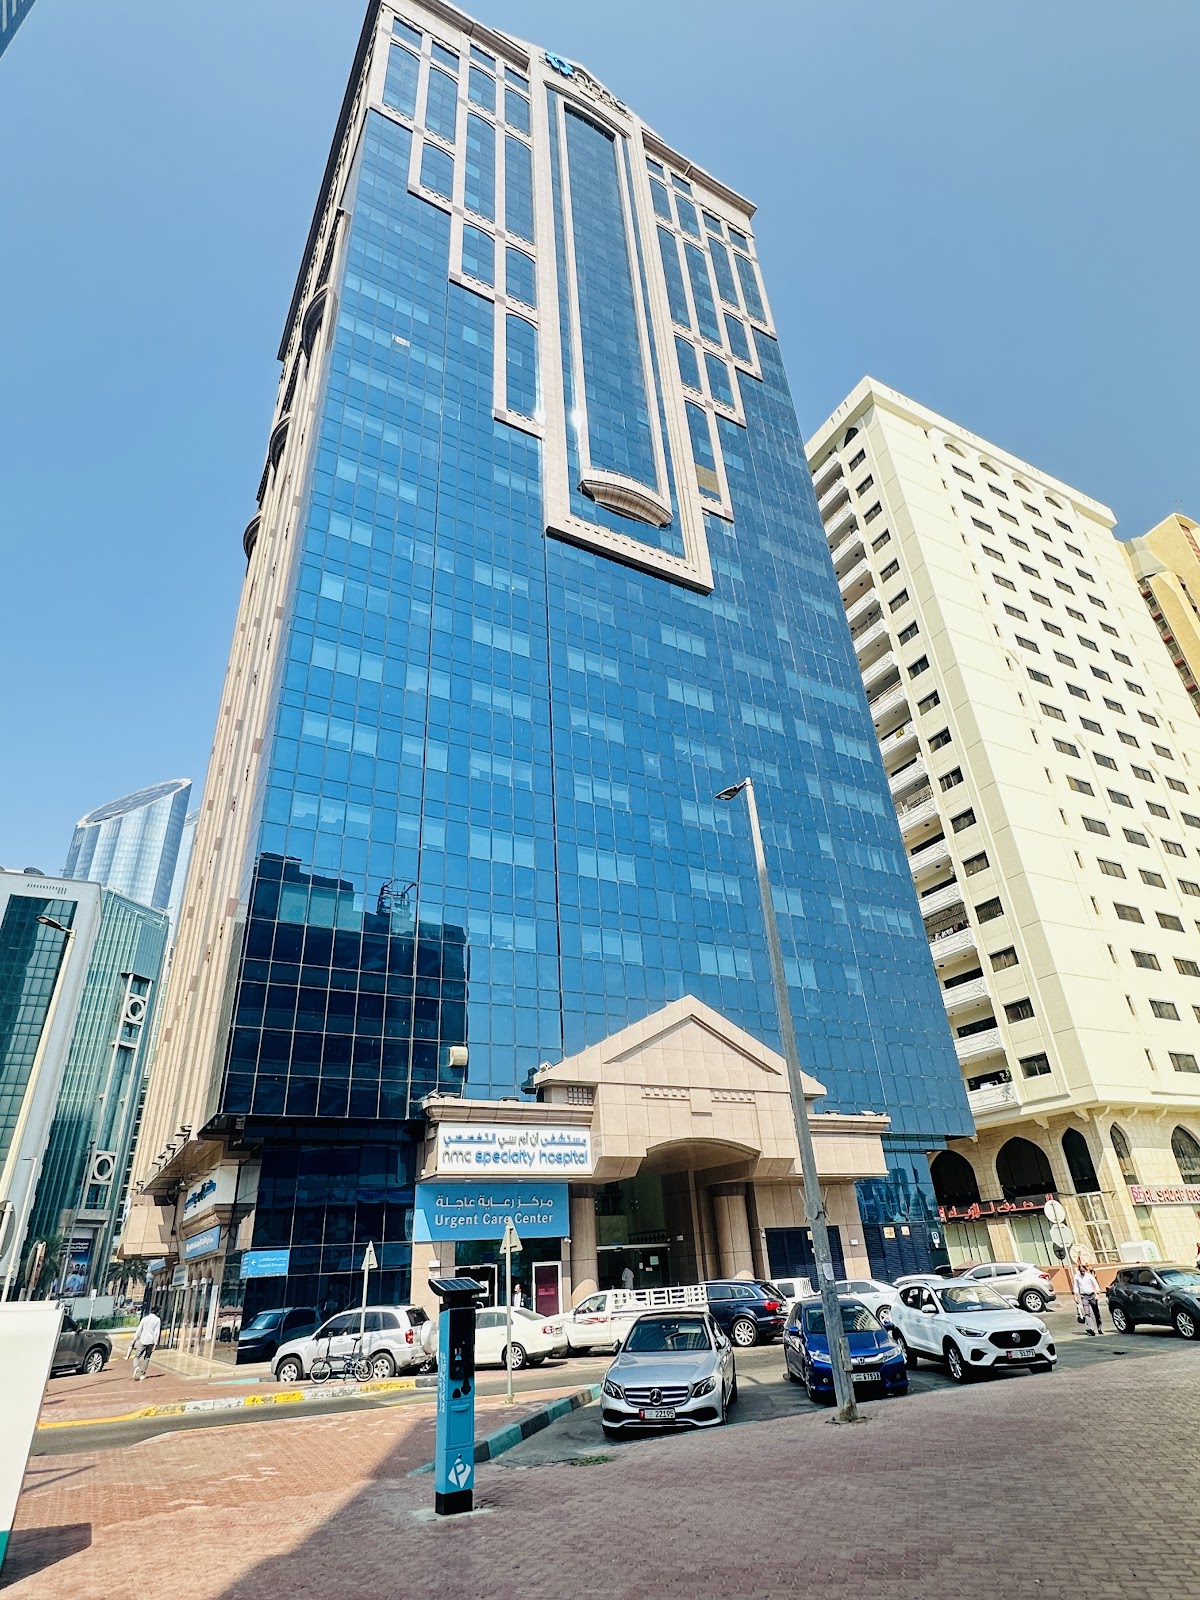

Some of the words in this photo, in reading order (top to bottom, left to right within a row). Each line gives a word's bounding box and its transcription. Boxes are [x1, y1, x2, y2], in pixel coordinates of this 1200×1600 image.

[442, 1150, 472, 1164] nmc
[475, 1149, 536, 1167] specialty
[539, 1149, 588, 1167] hospital
[435, 1195, 476, 1211] عاجلة
[477, 1194, 515, 1210] رعاية
[516, 1195, 554, 1209] مركز
[434, 1214, 479, 1229] Urgent
[482, 1213, 511, 1225] Care
[514, 1212, 554, 1224] Center
